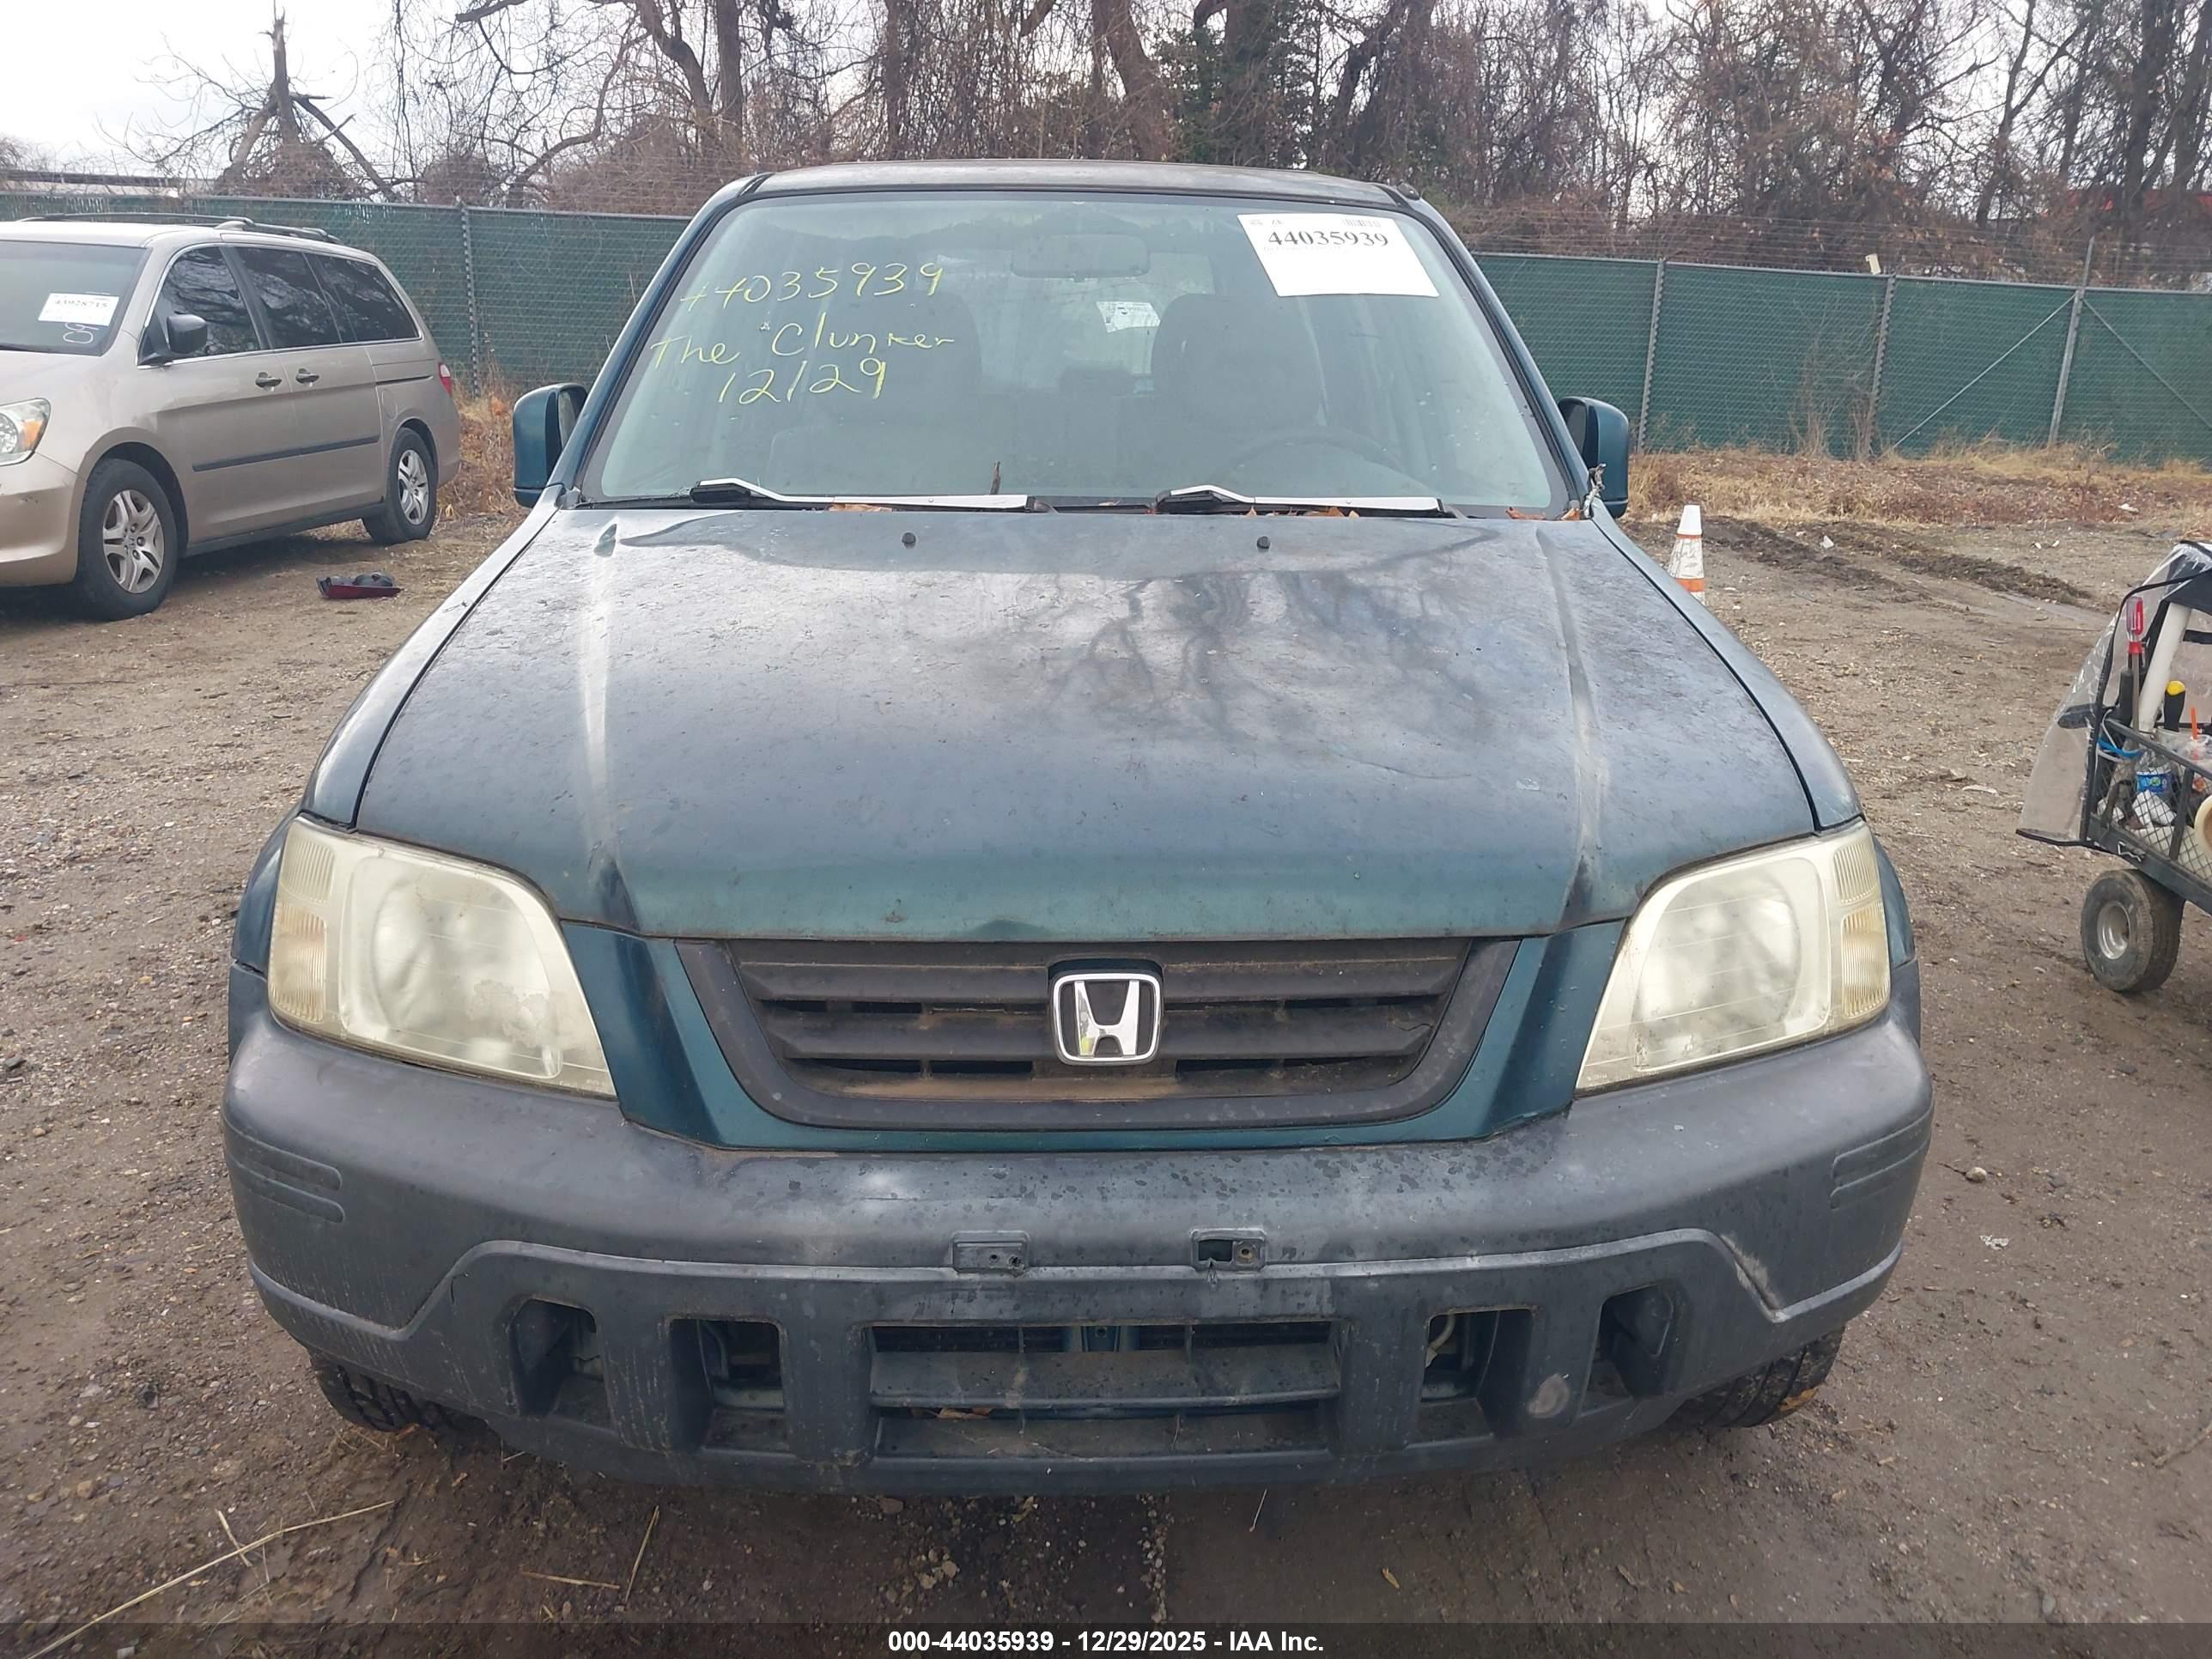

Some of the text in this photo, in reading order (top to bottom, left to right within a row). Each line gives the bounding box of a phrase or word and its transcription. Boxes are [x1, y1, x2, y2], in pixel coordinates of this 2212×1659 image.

[1268, 230, 1389, 246] 44035939
[650, 311, 956, 370] The Clunker
[718, 357, 887, 405] 12/29
